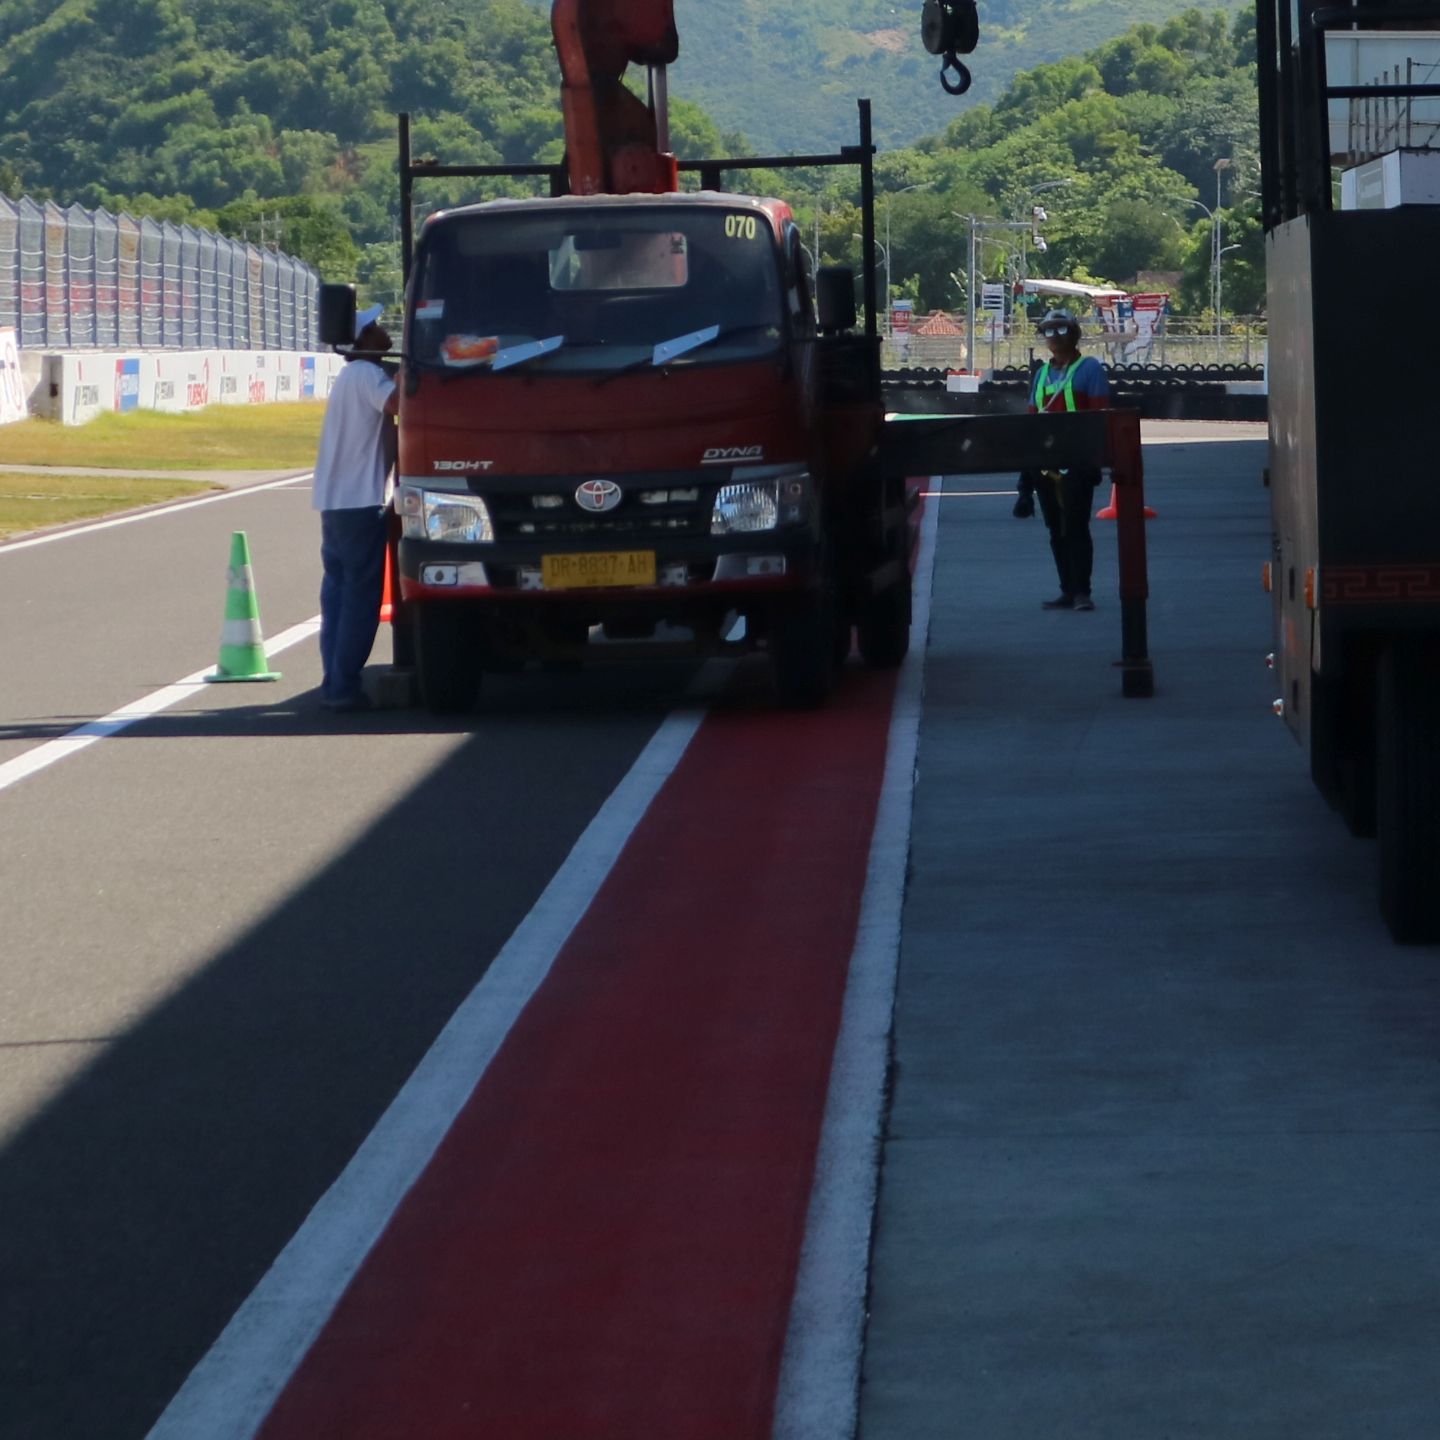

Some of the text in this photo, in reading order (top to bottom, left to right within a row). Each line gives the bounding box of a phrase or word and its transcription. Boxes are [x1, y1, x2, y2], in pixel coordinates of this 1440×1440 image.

[725, 215, 756, 240] 070
[704, 445, 762, 458] DYNA
[433, 460, 493, 470] 130HT
